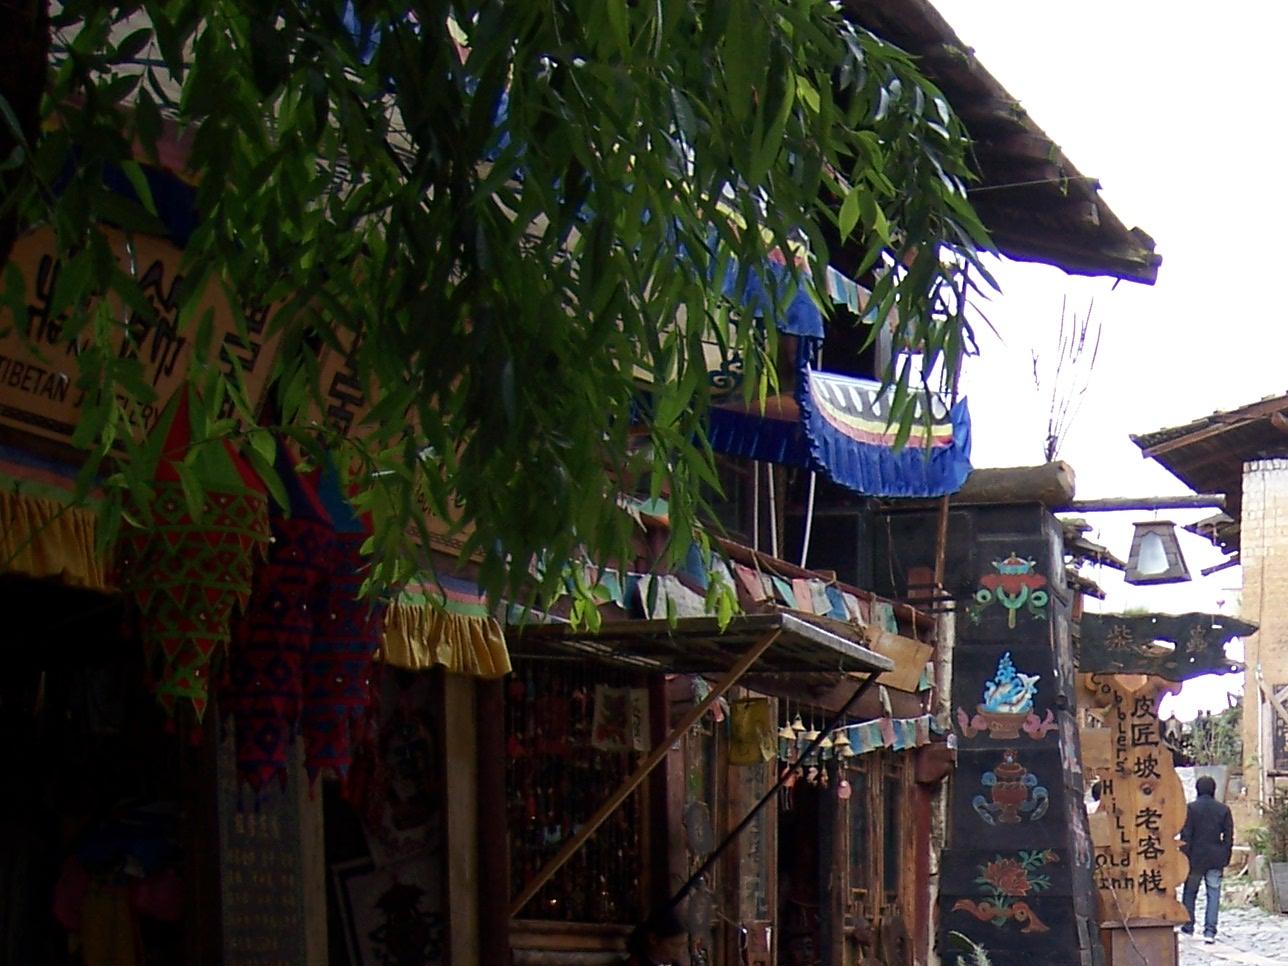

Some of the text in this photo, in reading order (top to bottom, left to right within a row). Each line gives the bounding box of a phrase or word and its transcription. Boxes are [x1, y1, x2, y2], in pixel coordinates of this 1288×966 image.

[0, 356, 70, 402] TIBETAN
[1131, 696, 1166, 894] 皮匠坡 老客栈
